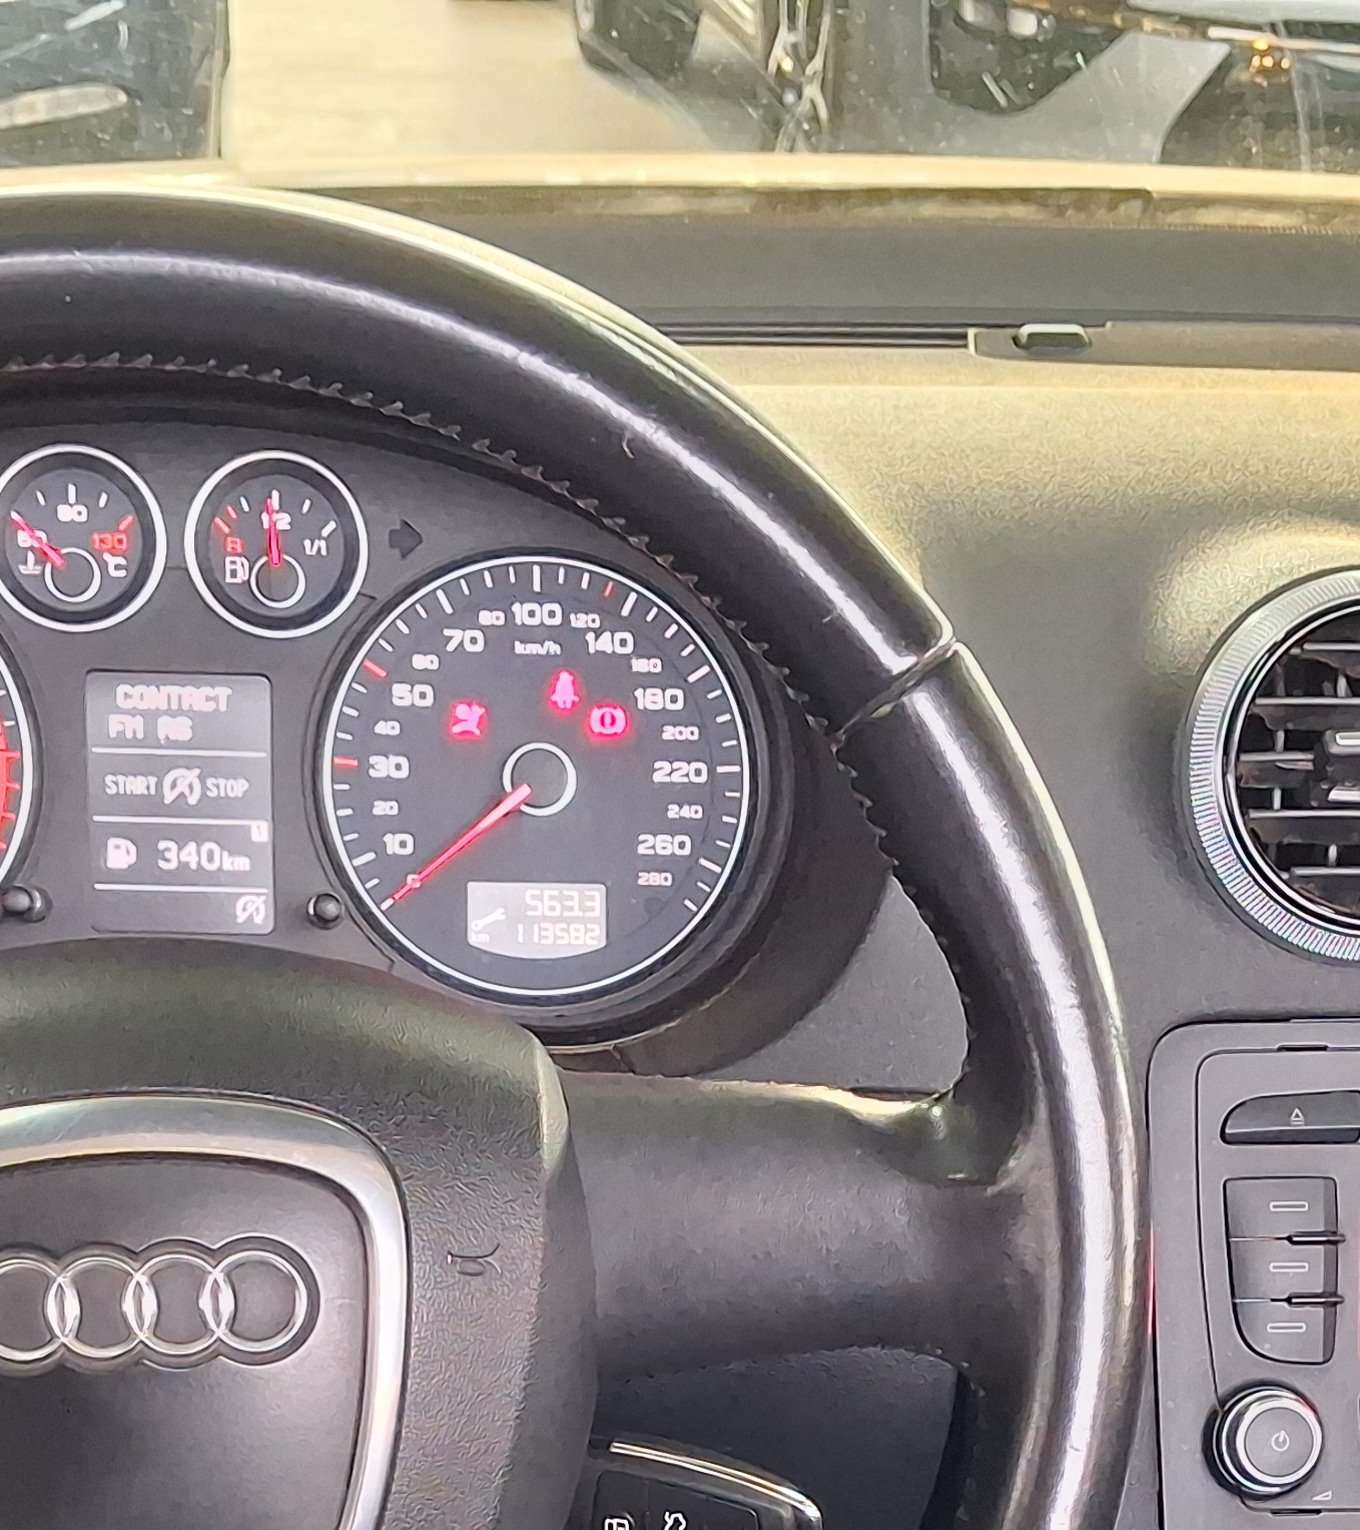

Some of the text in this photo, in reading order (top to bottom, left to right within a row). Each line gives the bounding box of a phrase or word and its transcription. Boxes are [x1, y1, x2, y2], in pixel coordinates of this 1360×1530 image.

[511, 602, 562, 626] 100
[569, 612, 601, 629] 120
[443, 628, 486, 653] 70
[585, 630, 635, 656] 140
[115, 684, 233, 712] CONTACT
[391, 683, 435, 708] 50
[632, 686, 686, 711] 180
[108, 714, 145, 739] FM
[373, 719, 402, 737] 40
[661, 725, 700, 742] 200
[367, 754, 411, 780] 30
[651, 761, 709, 785] 220
[104, 774, 250, 799] START STOP
[371, 800, 400, 817] 20
[666, 804, 704, 820] 240
[382, 833, 415, 856] 10
[636, 834, 693, 857] 260
[637, 871, 674, 887] 280
